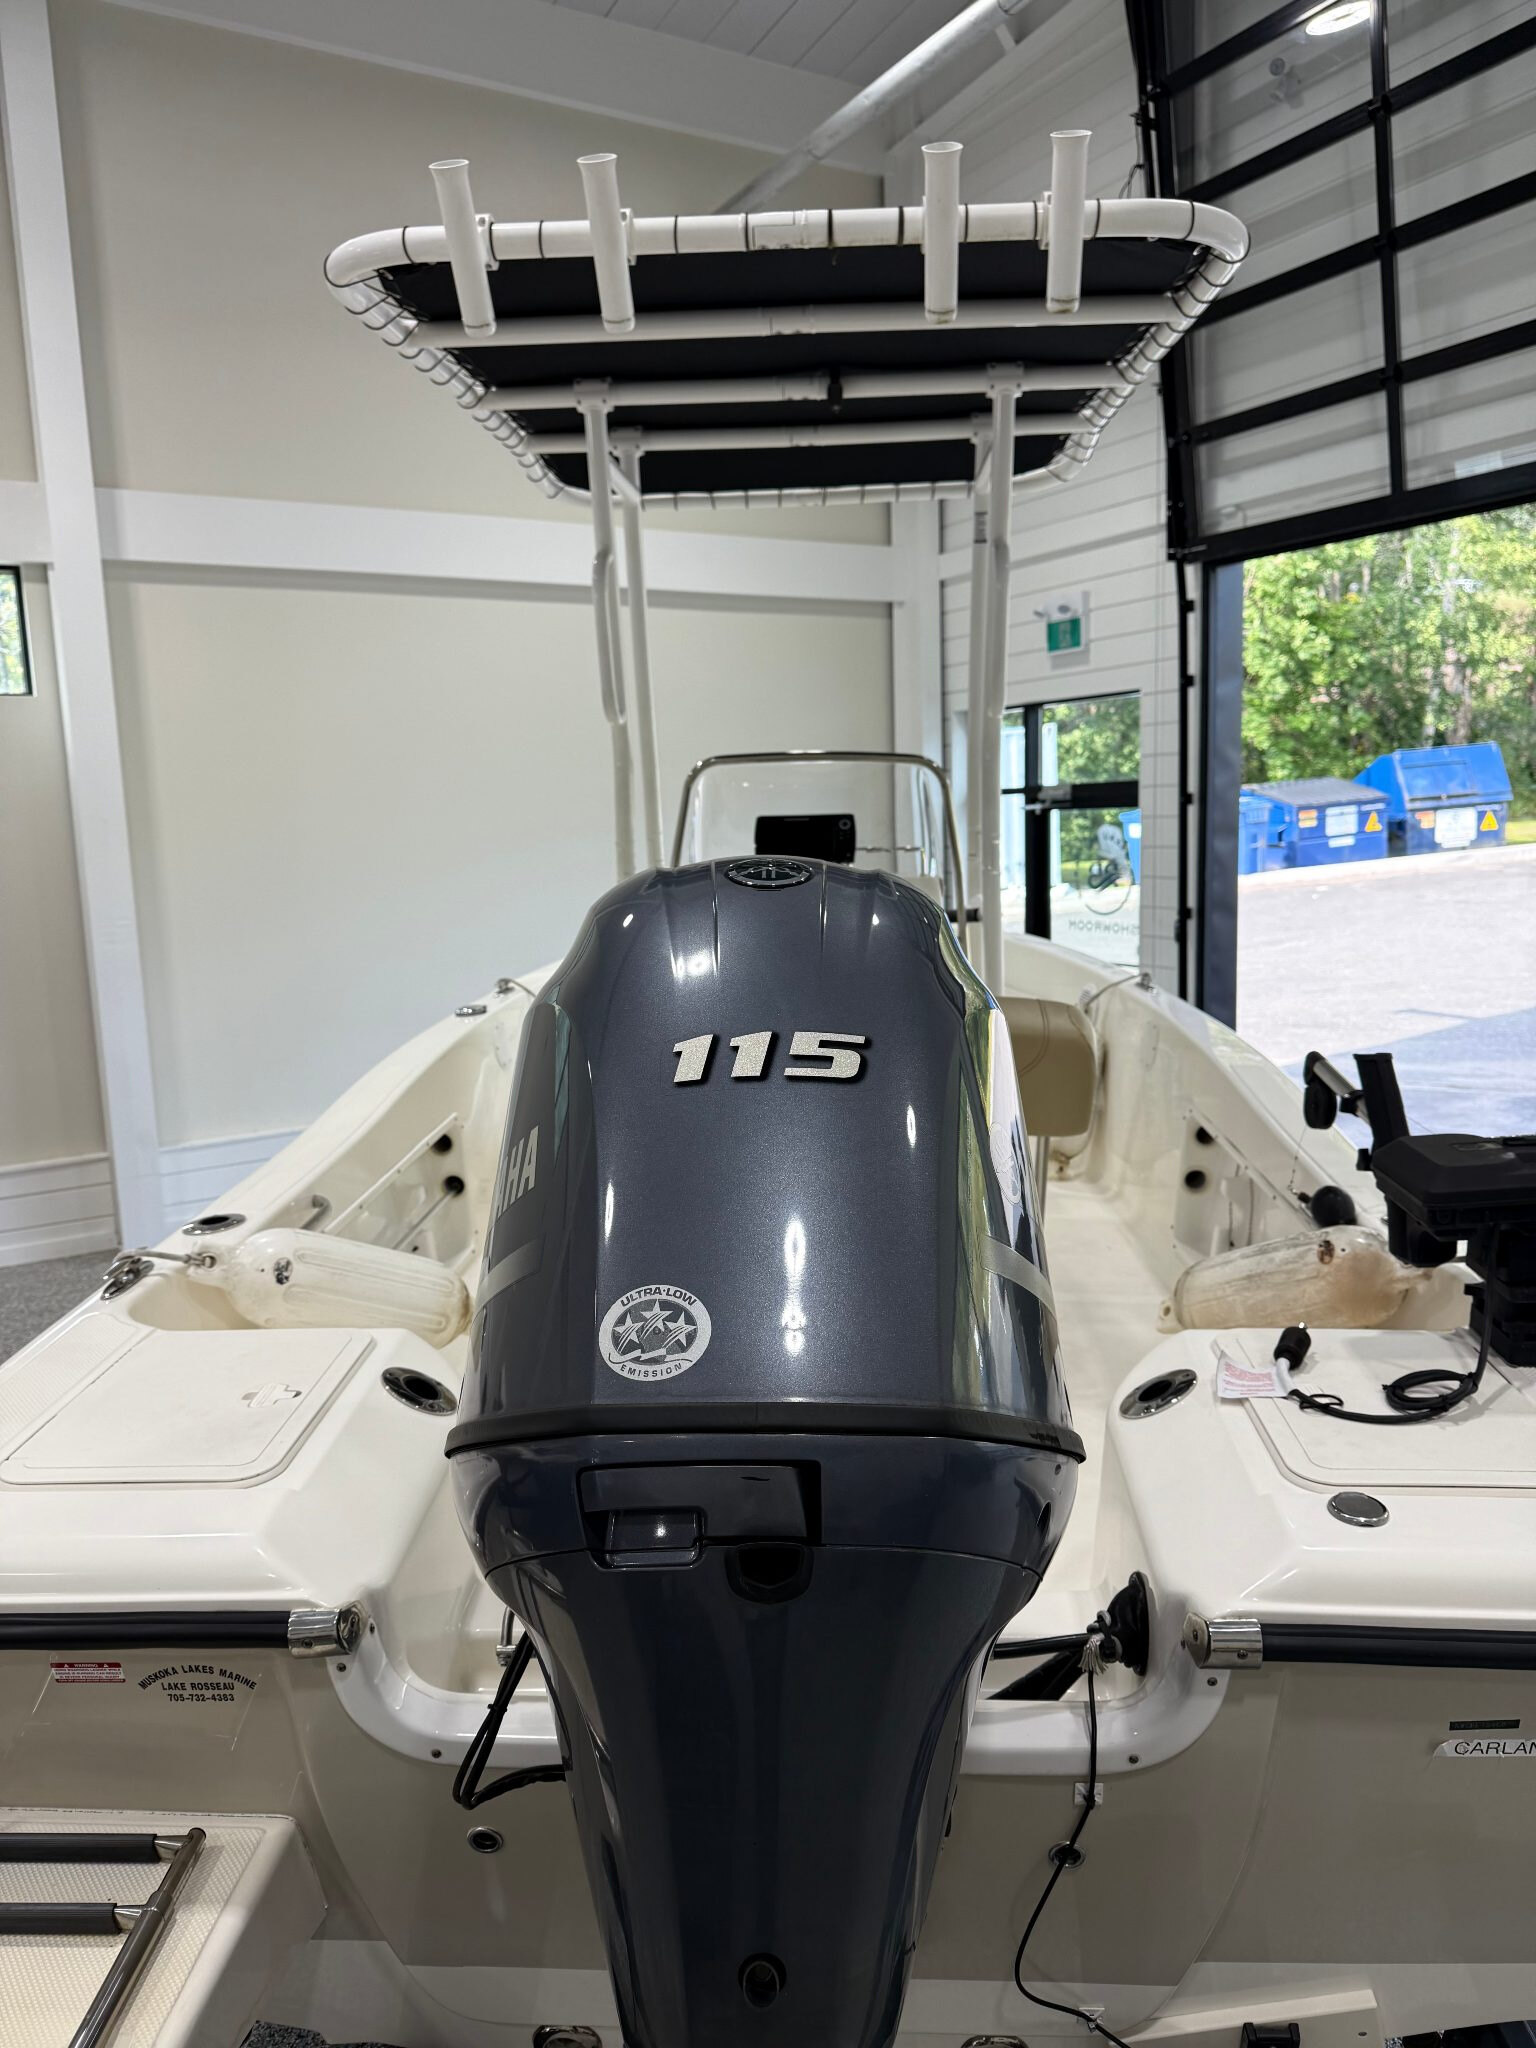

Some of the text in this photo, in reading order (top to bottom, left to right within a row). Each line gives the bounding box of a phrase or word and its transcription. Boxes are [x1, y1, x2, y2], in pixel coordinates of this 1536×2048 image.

[672, 1031, 868, 1083] 115
[620, 1362, 682, 1377] EMISSION
[138, 1665, 257, 1690] MUSKOKA LAKES MARINE
[161, 1682, 235, 1691] LAKE ROSSEAU
[167, 1693, 235, 1702] 705-732-4383
